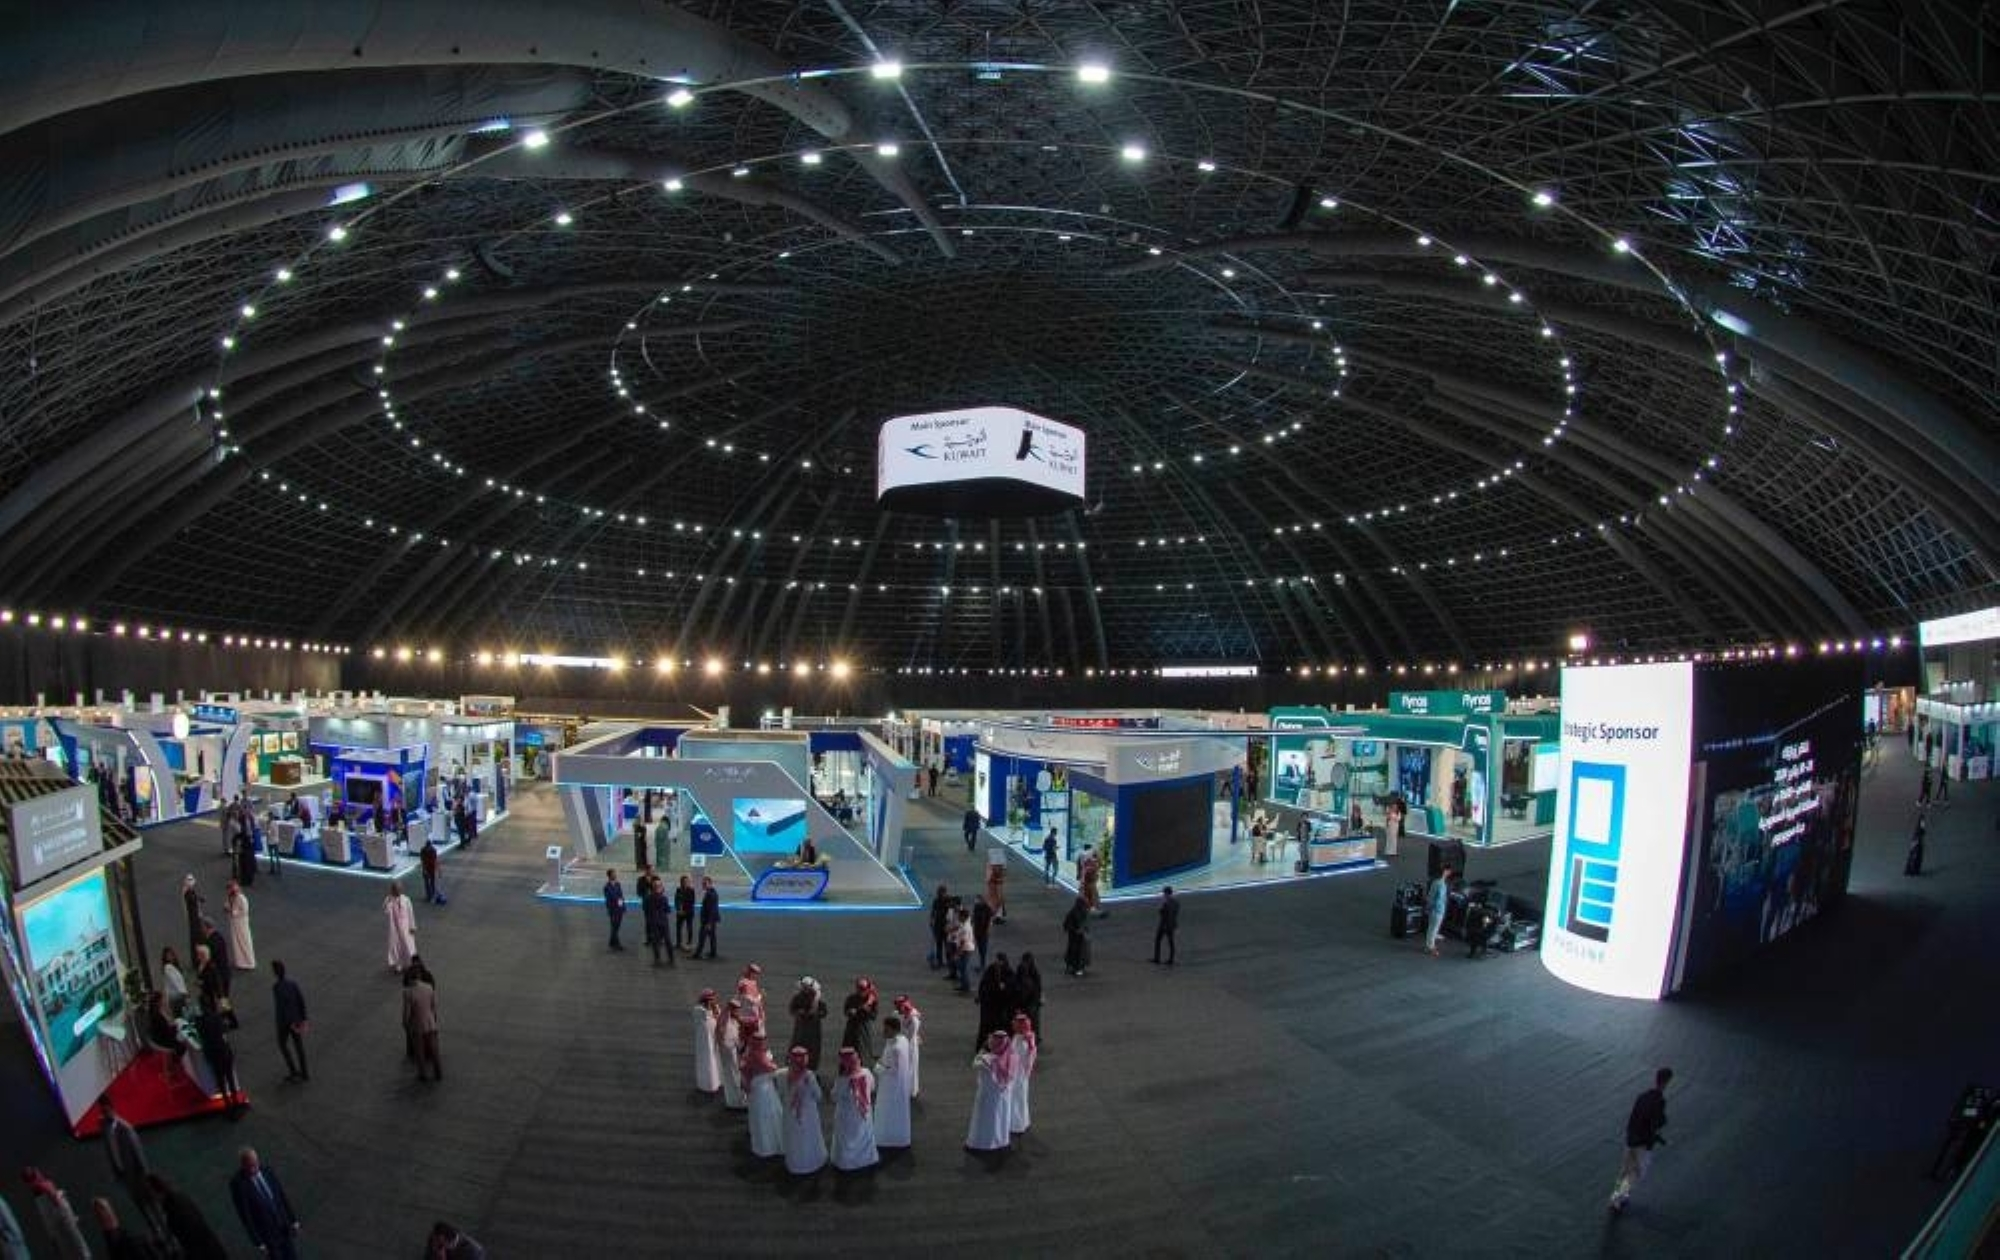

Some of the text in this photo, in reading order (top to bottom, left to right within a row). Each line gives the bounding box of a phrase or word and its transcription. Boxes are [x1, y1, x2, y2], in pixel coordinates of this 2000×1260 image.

[910, 418, 971, 431] Main Sponsor
[943, 448, 986, 461] KUWAIT
[1599, 722, 1659, 743] Sponsor
